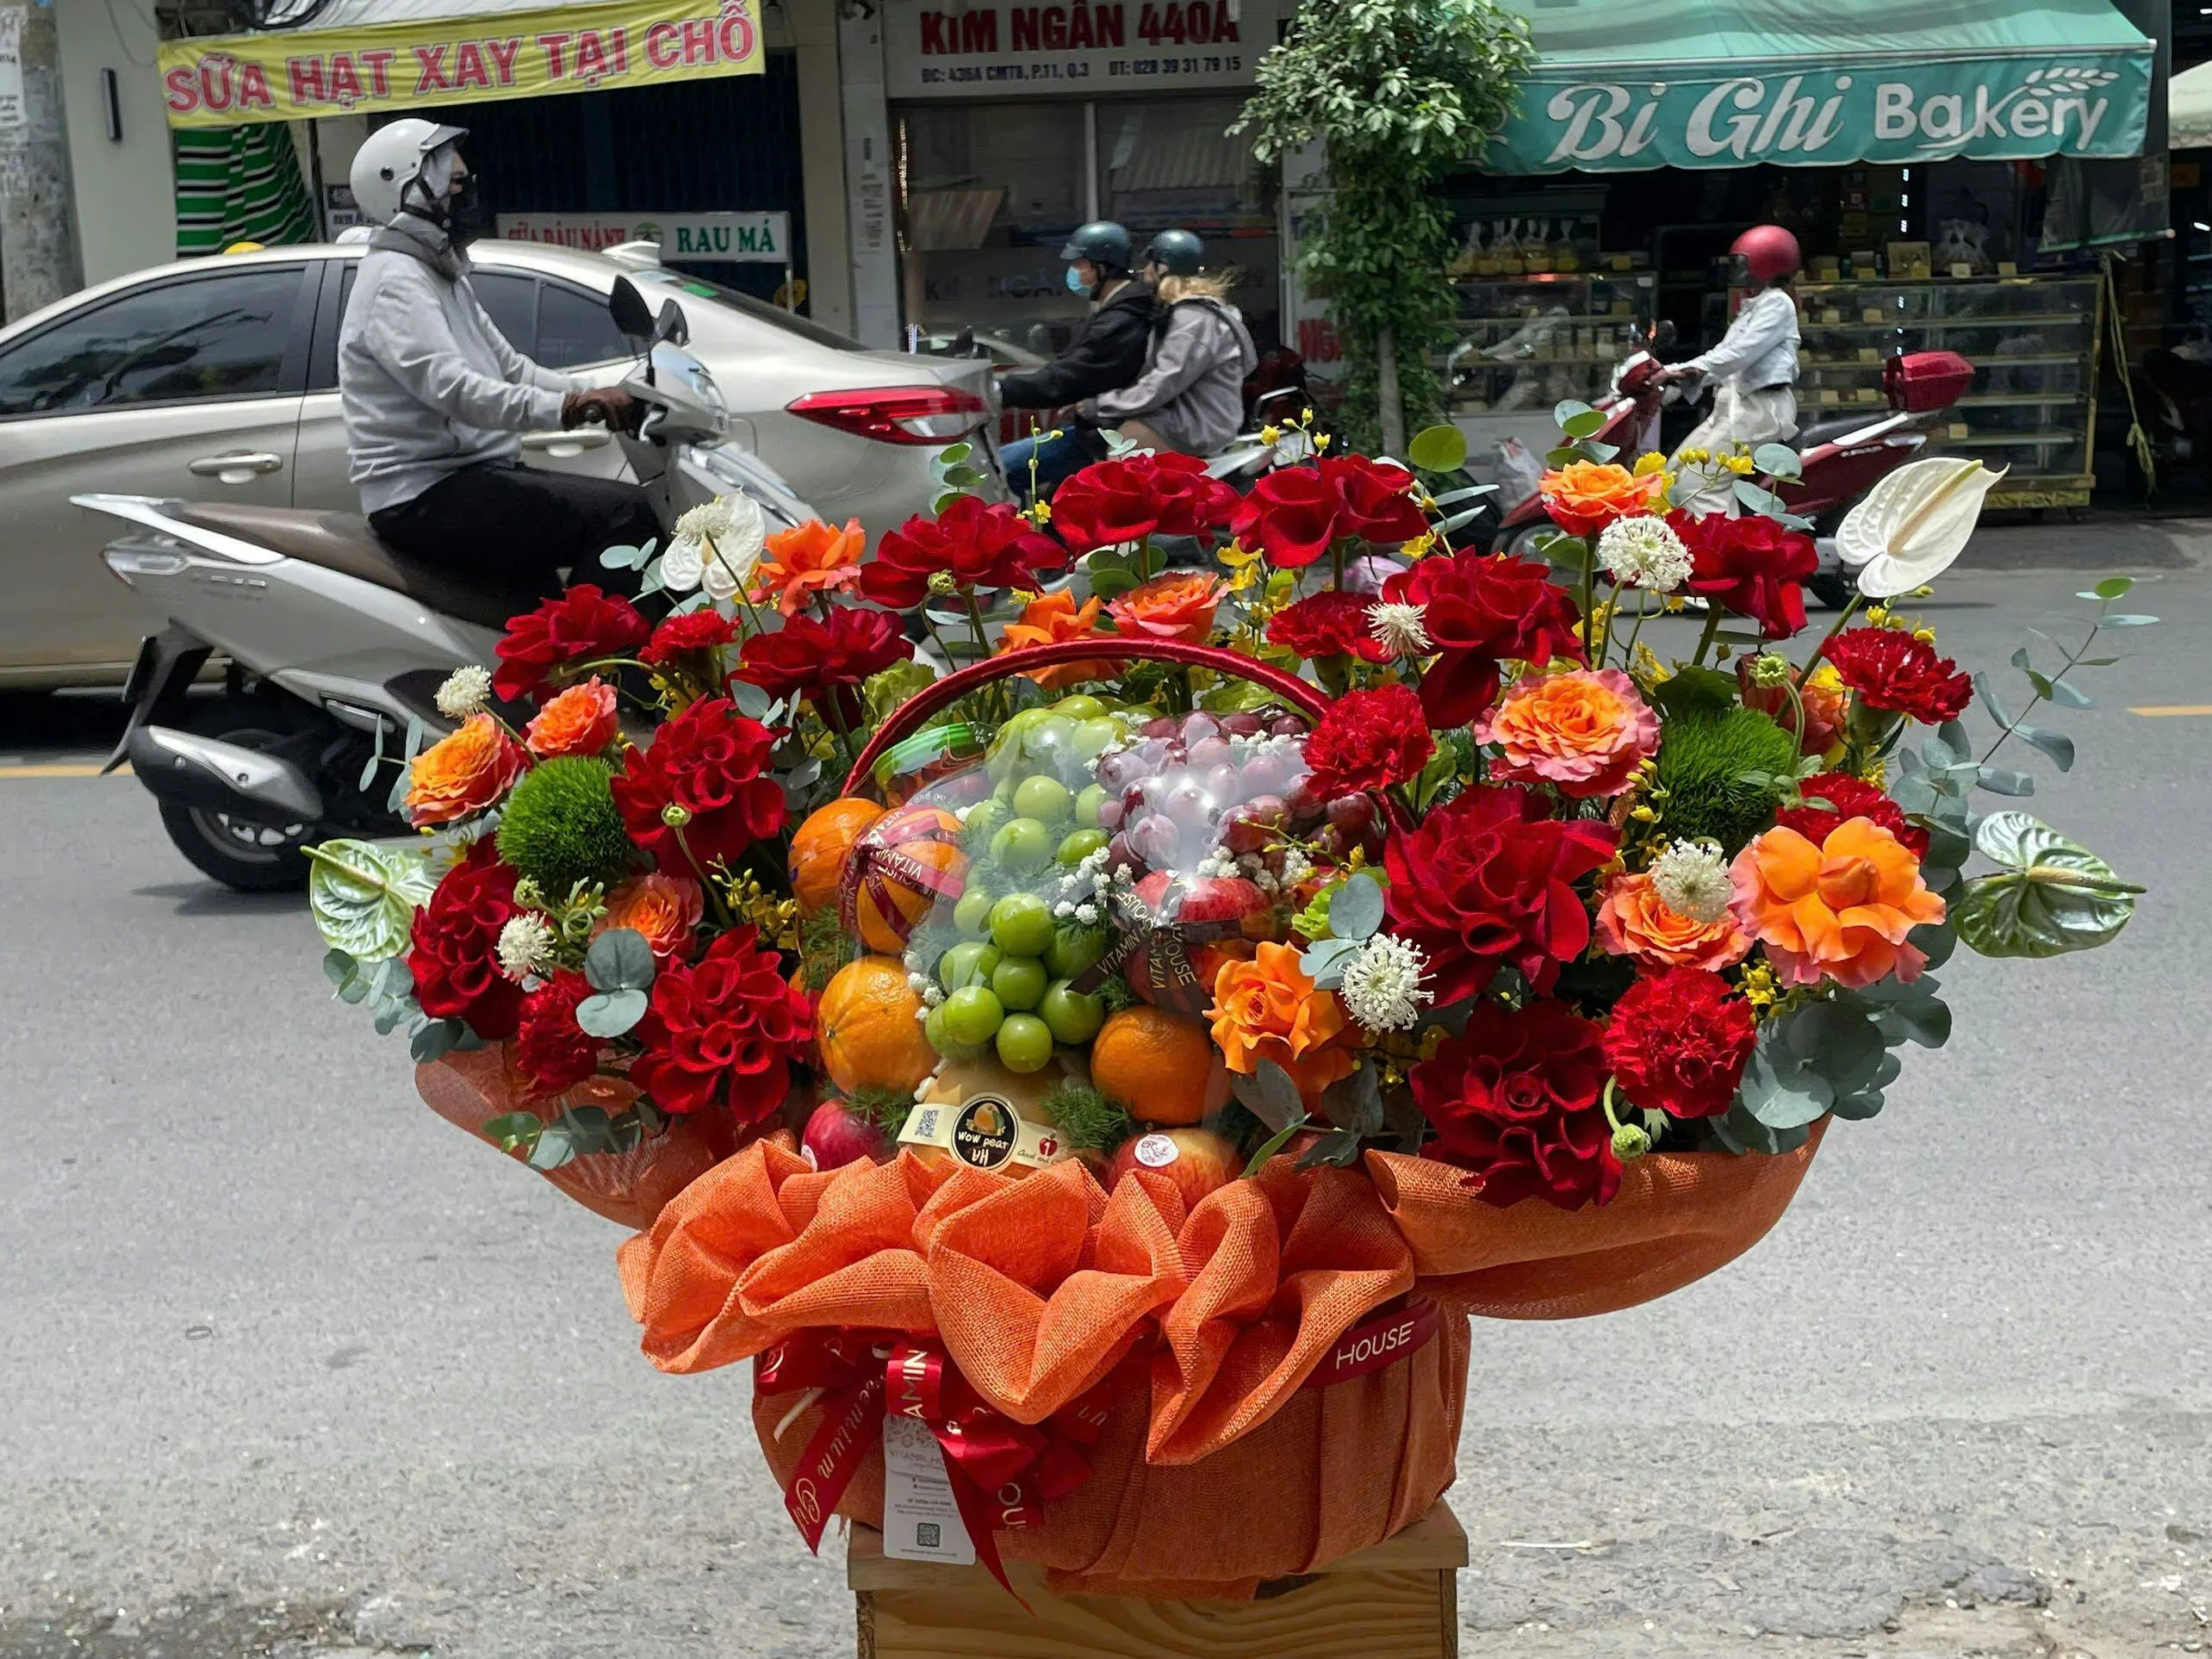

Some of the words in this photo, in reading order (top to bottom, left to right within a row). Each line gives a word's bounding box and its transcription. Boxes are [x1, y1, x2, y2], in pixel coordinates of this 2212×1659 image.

[921, 9, 998, 54] KIM
[1011, 0, 1125, 51] NGÂN
[1137, 0, 1240, 46] 440A
[165, 53, 275, 113] SỮA
[286, 47, 396, 110] HẠT
[411, 35, 524, 95] XAY
[536, 27, 631, 89] TẠI
[643, 0, 758, 70] CHỖ
[1067, 62, 1090, 78] Q.3
[1183, 58, 1199, 72] 31
[1203, 57, 1221, 71] 79
[1225, 56, 1242, 71] 15
[1544, 82, 1666, 164] Bi
[1686, 76, 1853, 160] Ghi
[1875, 84, 2109, 151] Bakery
[676, 227, 730, 252] RAU
[738, 219, 776, 252] MÁ
[1096, 929, 1140, 975] VITAMIN
[1336, 1320, 1415, 1370] HOUSE
[901, 1350, 928, 1420] AMIN
